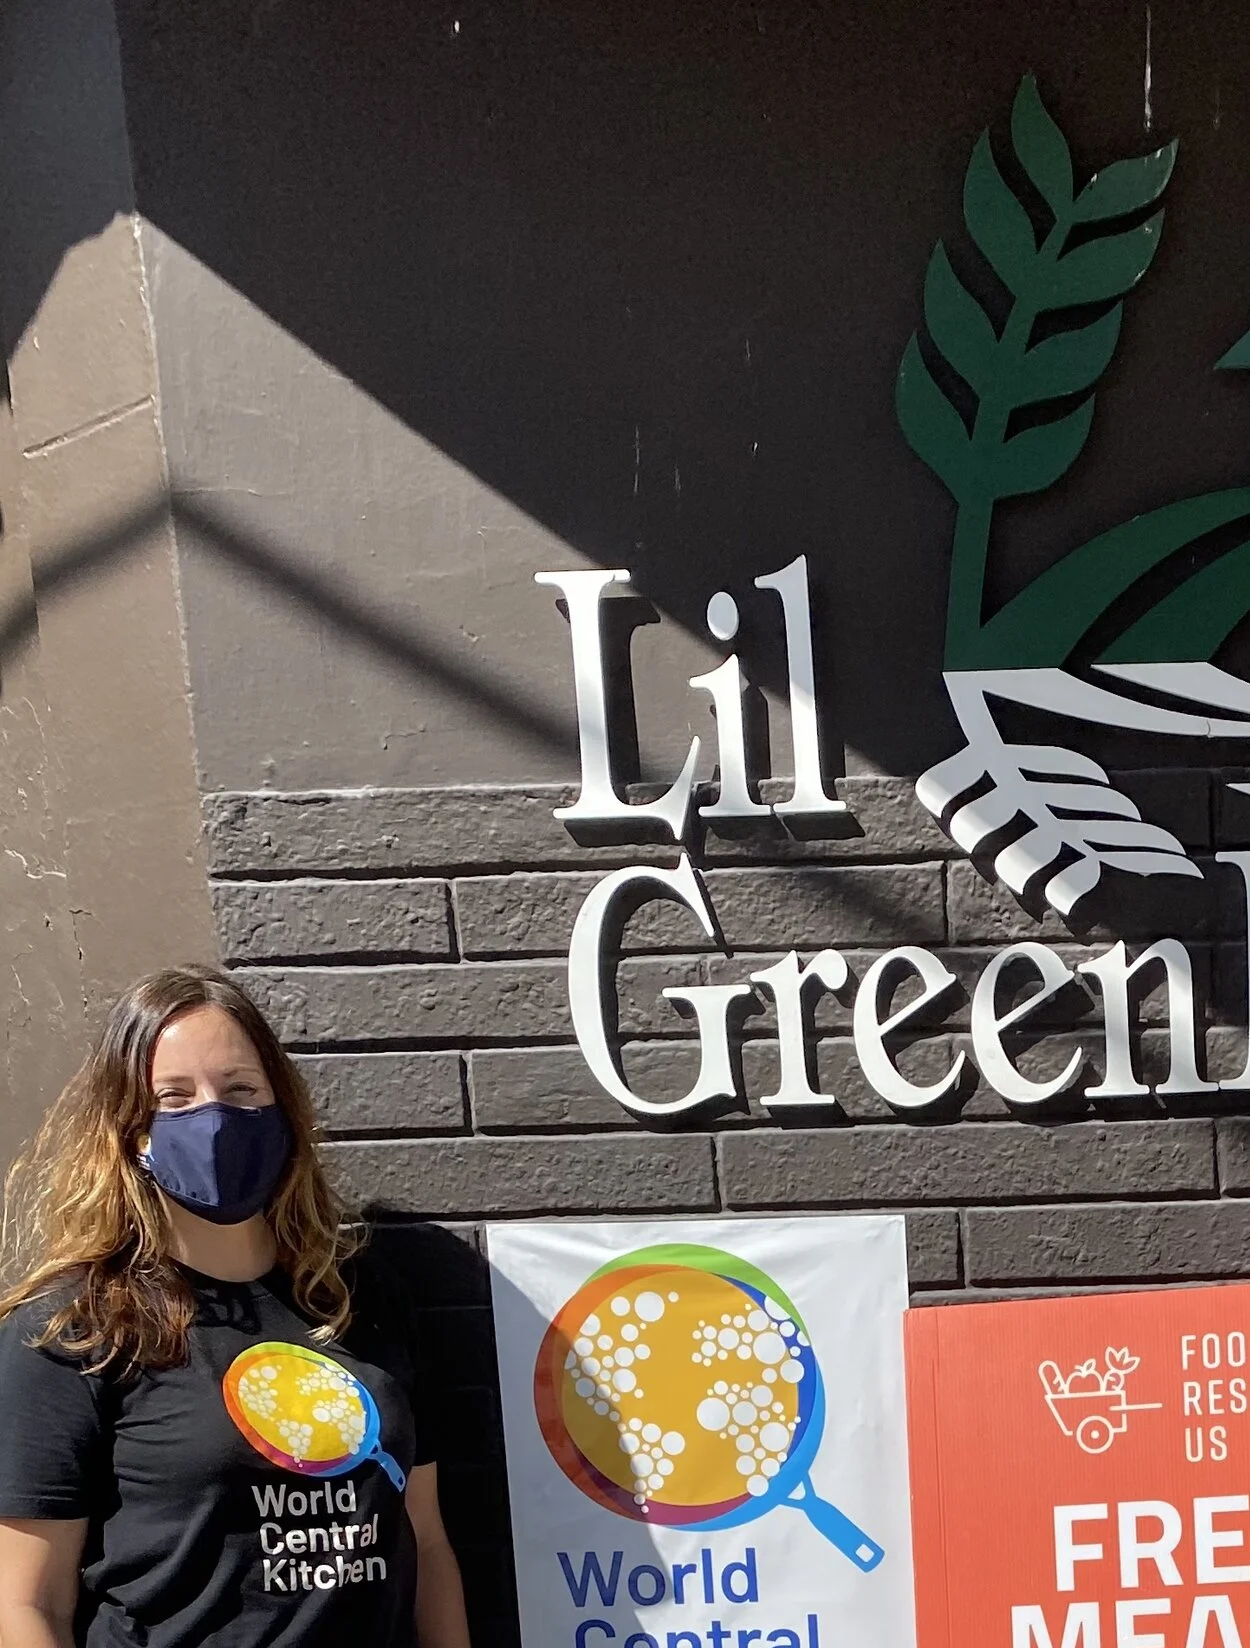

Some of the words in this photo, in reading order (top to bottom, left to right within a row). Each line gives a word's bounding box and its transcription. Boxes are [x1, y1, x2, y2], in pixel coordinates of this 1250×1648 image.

[534, 555, 846, 841] Lil
[1185, 1425, 1228, 1463] US
[251, 1480, 357, 1517] World
[260, 1513, 379, 1555] Central
[263, 1555, 387, 1592] Kitchen
[557, 1547, 760, 1608] World
